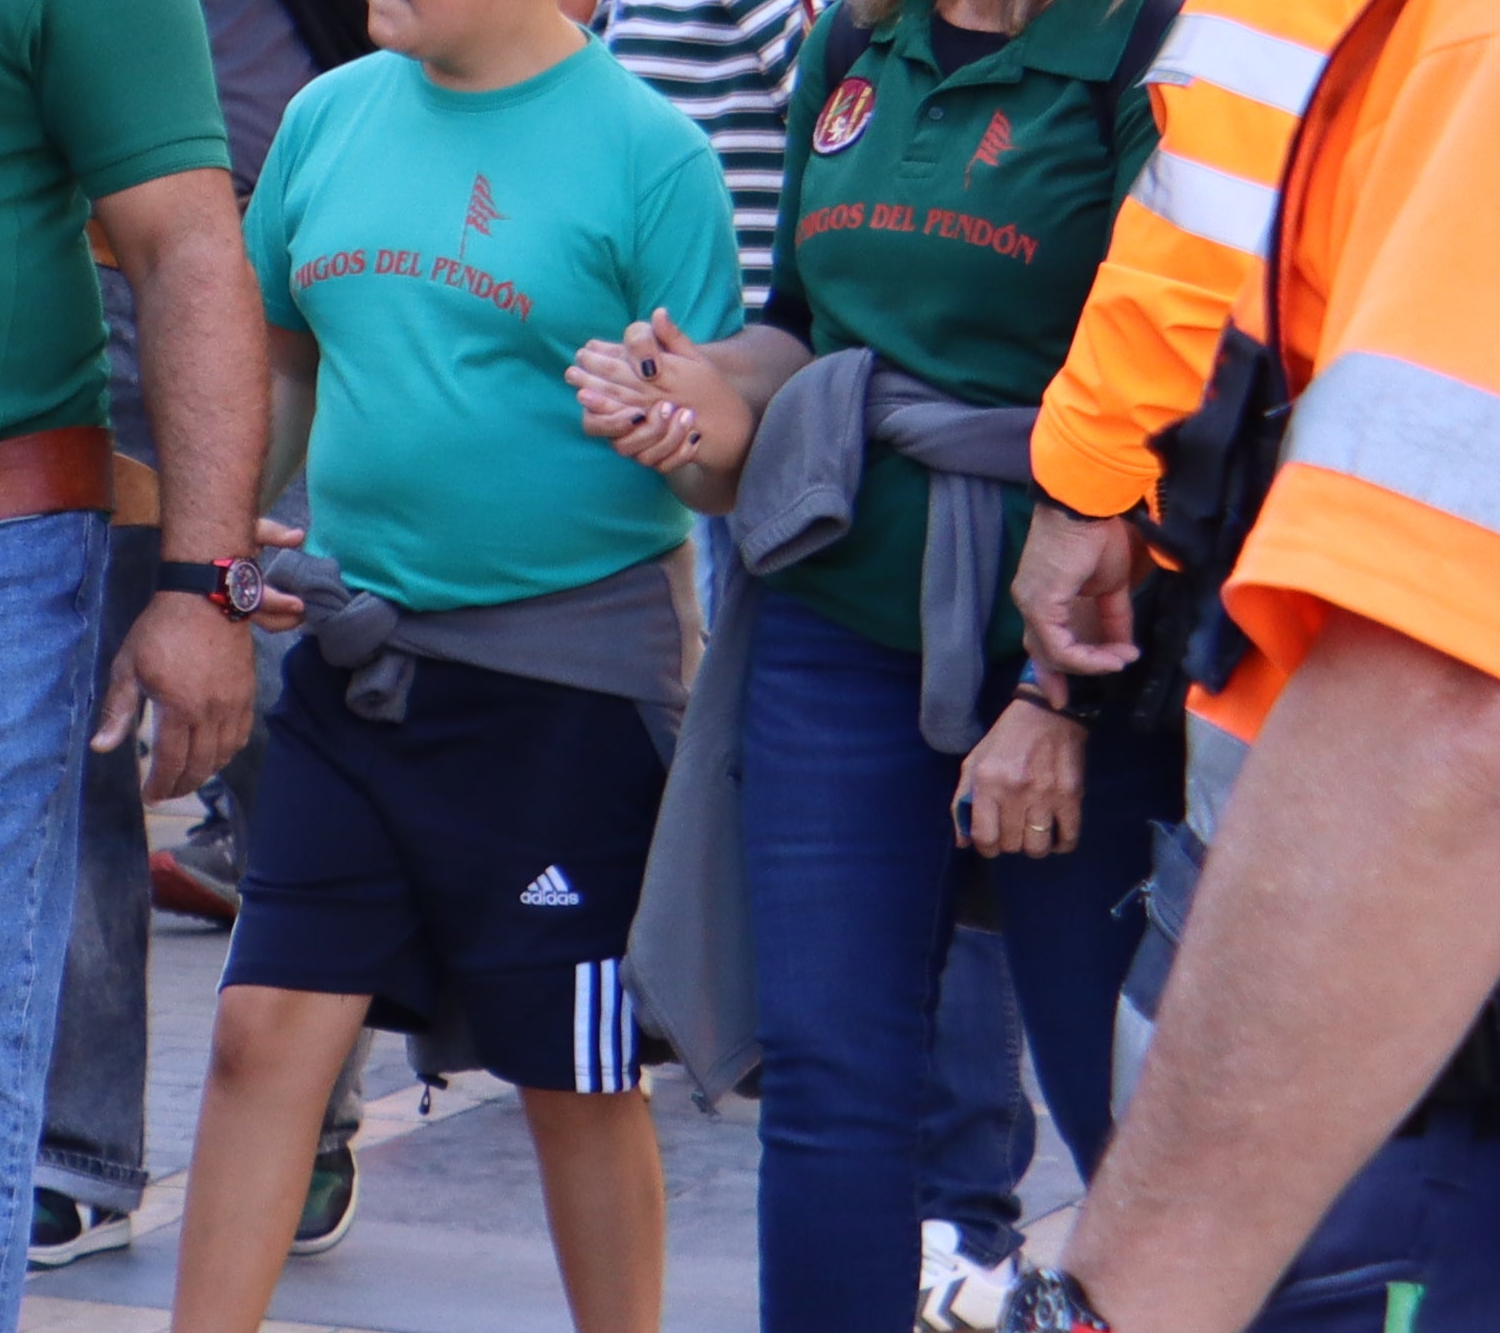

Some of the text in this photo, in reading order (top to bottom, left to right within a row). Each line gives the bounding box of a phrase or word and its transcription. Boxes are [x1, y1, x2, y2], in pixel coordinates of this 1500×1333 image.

[869, 202, 915, 233] DEL
[923, 208, 1039, 265] PENDÓN
[373, 249, 424, 278] DEL
[429, 255, 534, 324] PENDÓN
[519, 890, 580, 907] adidas
